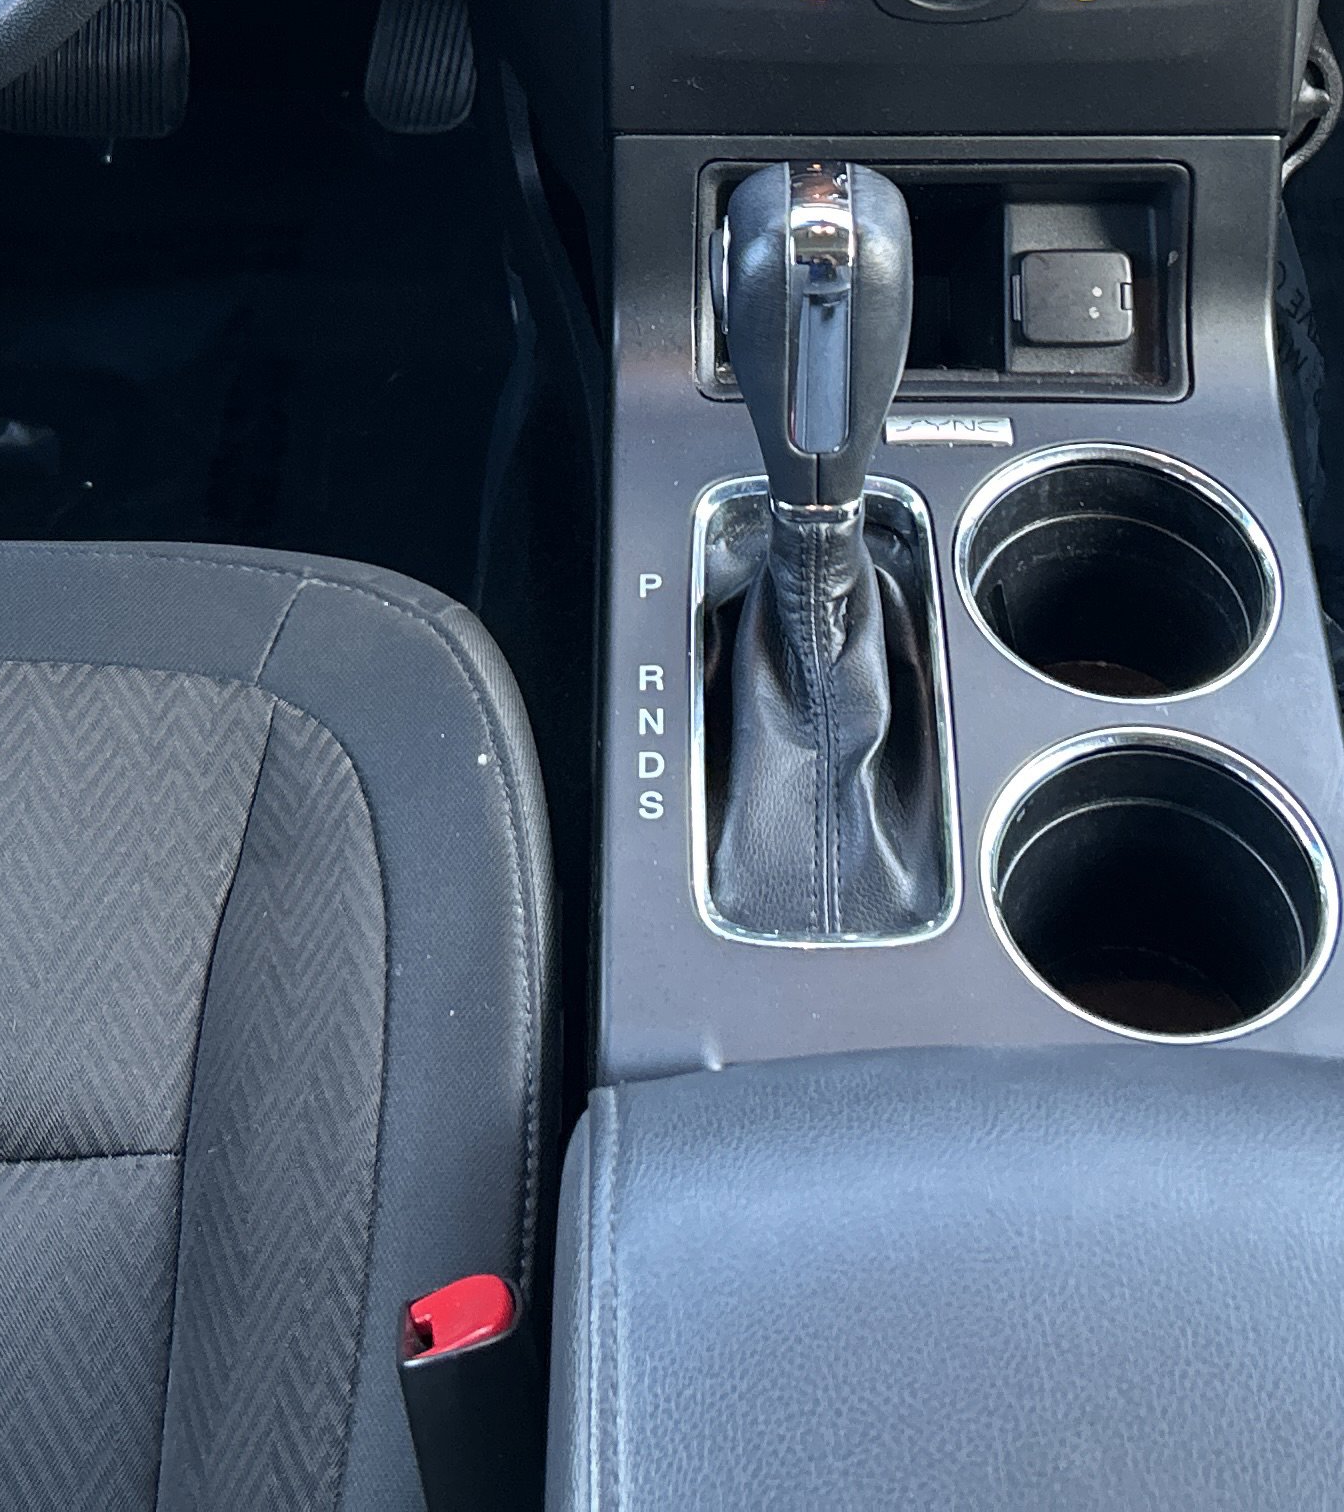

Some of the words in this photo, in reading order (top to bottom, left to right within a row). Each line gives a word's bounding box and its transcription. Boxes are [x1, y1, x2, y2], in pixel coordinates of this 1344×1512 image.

[895, 419, 999, 433] SYNC
[639, 573, 663, 598] P
[639, 664, 664, 691] R
[639, 708, 664, 735] N
[638, 751, 665, 779] D
[638, 790, 665, 820] S
